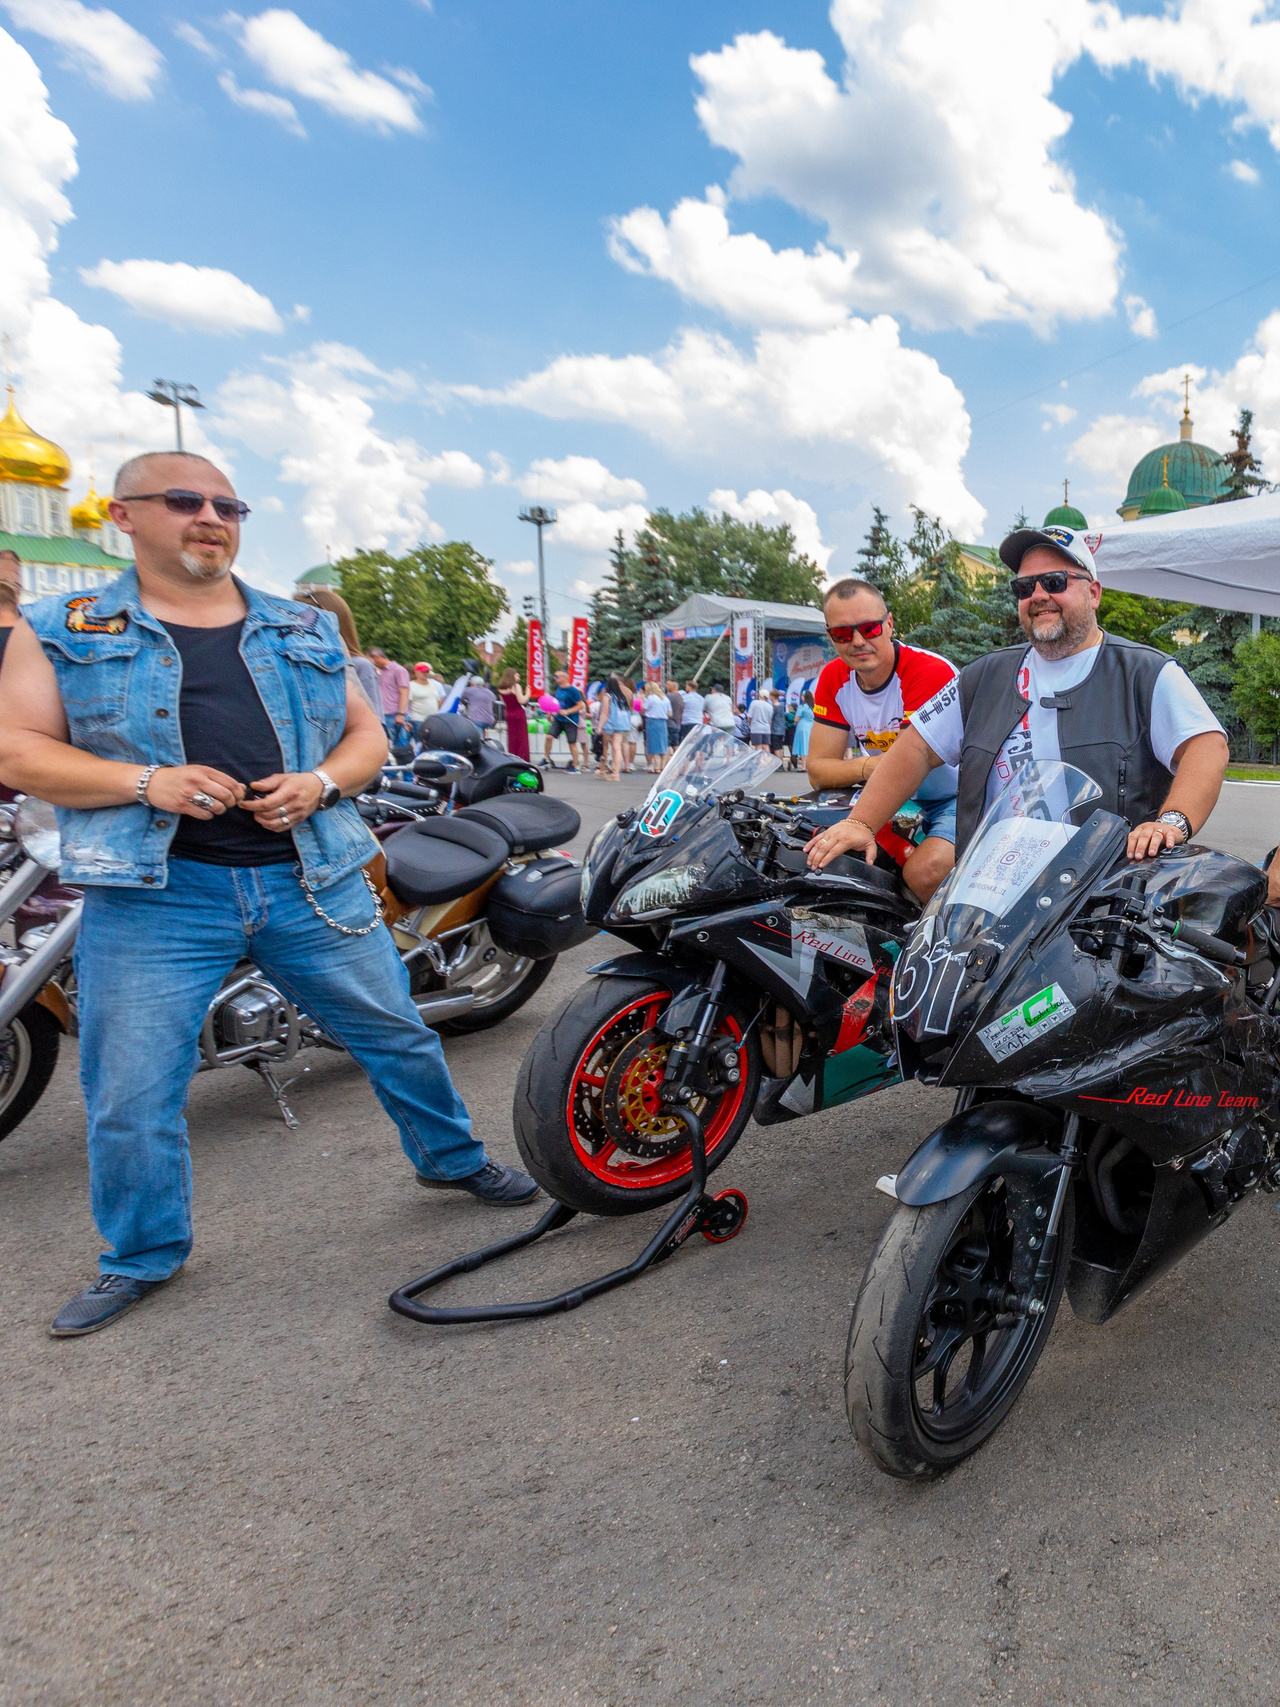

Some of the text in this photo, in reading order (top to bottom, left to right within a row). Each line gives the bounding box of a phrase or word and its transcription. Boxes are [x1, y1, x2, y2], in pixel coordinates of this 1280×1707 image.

[532, 629, 545, 690] auto.ru
[571, 627, 587, 691] auto.ru
[792, 930, 835, 952] Red
[834, 941, 866, 966] Line
[1127, 1086, 1260, 1108] Red Line Team
